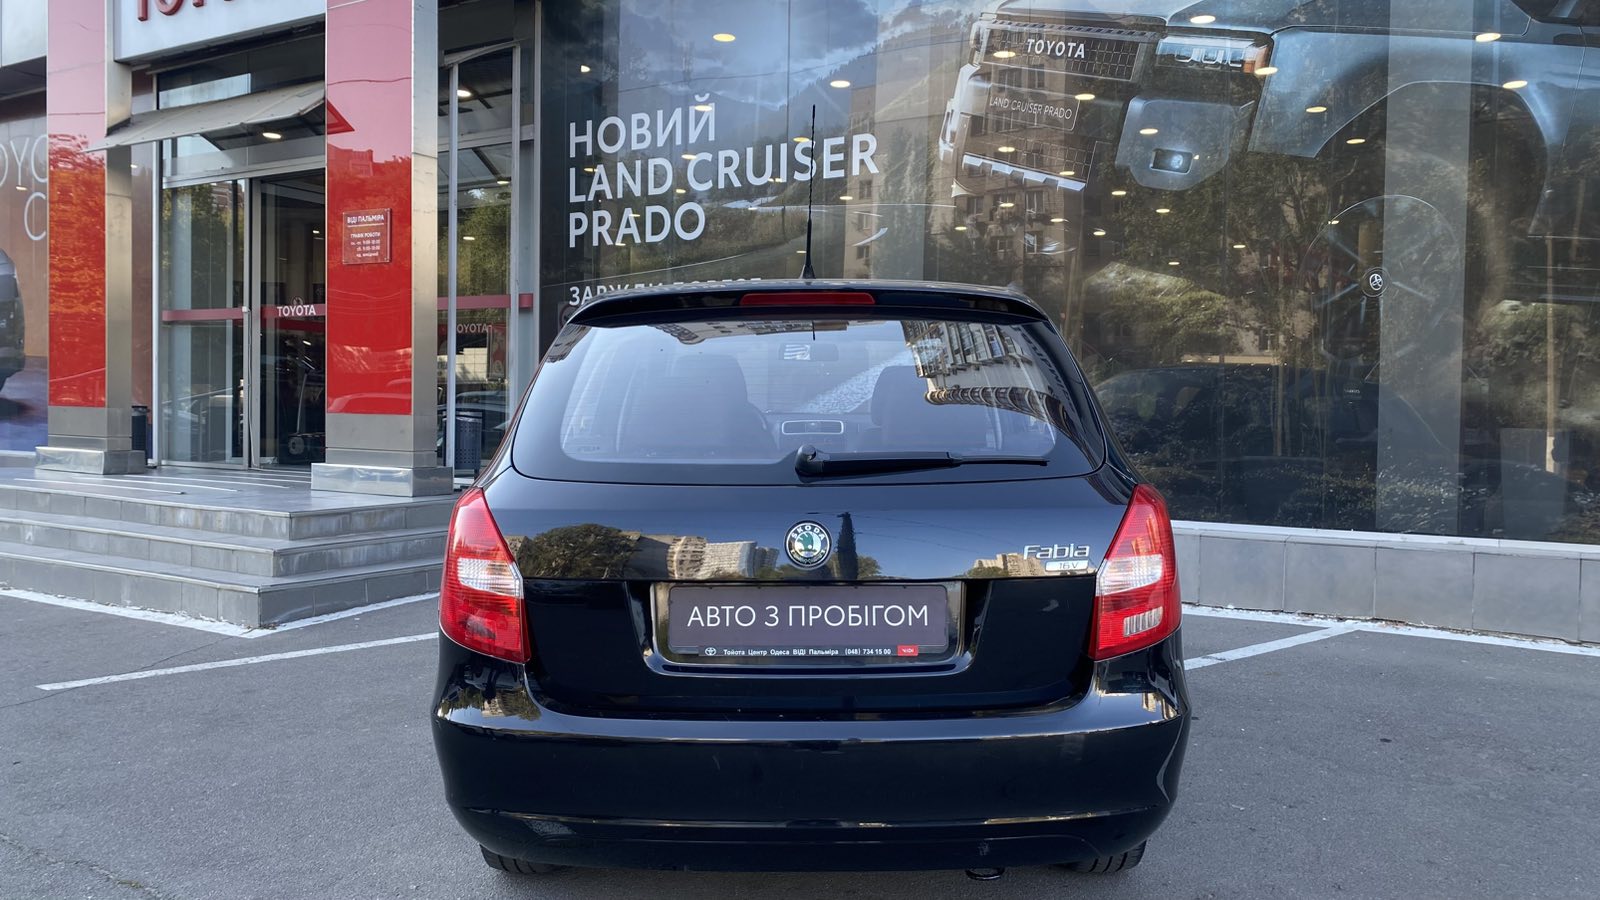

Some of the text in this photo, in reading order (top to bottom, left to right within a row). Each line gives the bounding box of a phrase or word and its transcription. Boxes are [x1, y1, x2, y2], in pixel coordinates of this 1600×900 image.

[1027, 39, 1085, 59] TOYOTA
[989, 96, 1073, 120] LAND CRUISER PRADO
[569, 92, 716, 158] НОВИЙ
[569, 132, 880, 204] LAND CRUISER
[569, 201, 706, 248] PRADO
[276, 304, 317, 318] TOYOTA
[456, 323, 489, 334] OYOTA
[687, 604, 757, 628] АВТО
[788, 604, 929, 628] ПРОБІГОМ
[723, 648, 746, 656] Тойота
[748, 648, 768, 657] Центр
[770, 648, 790, 657] Одеса
[808, 648, 839, 657] Пальміра
[844, 647, 861, 656] (048)
[862, 648, 874, 656] 734
